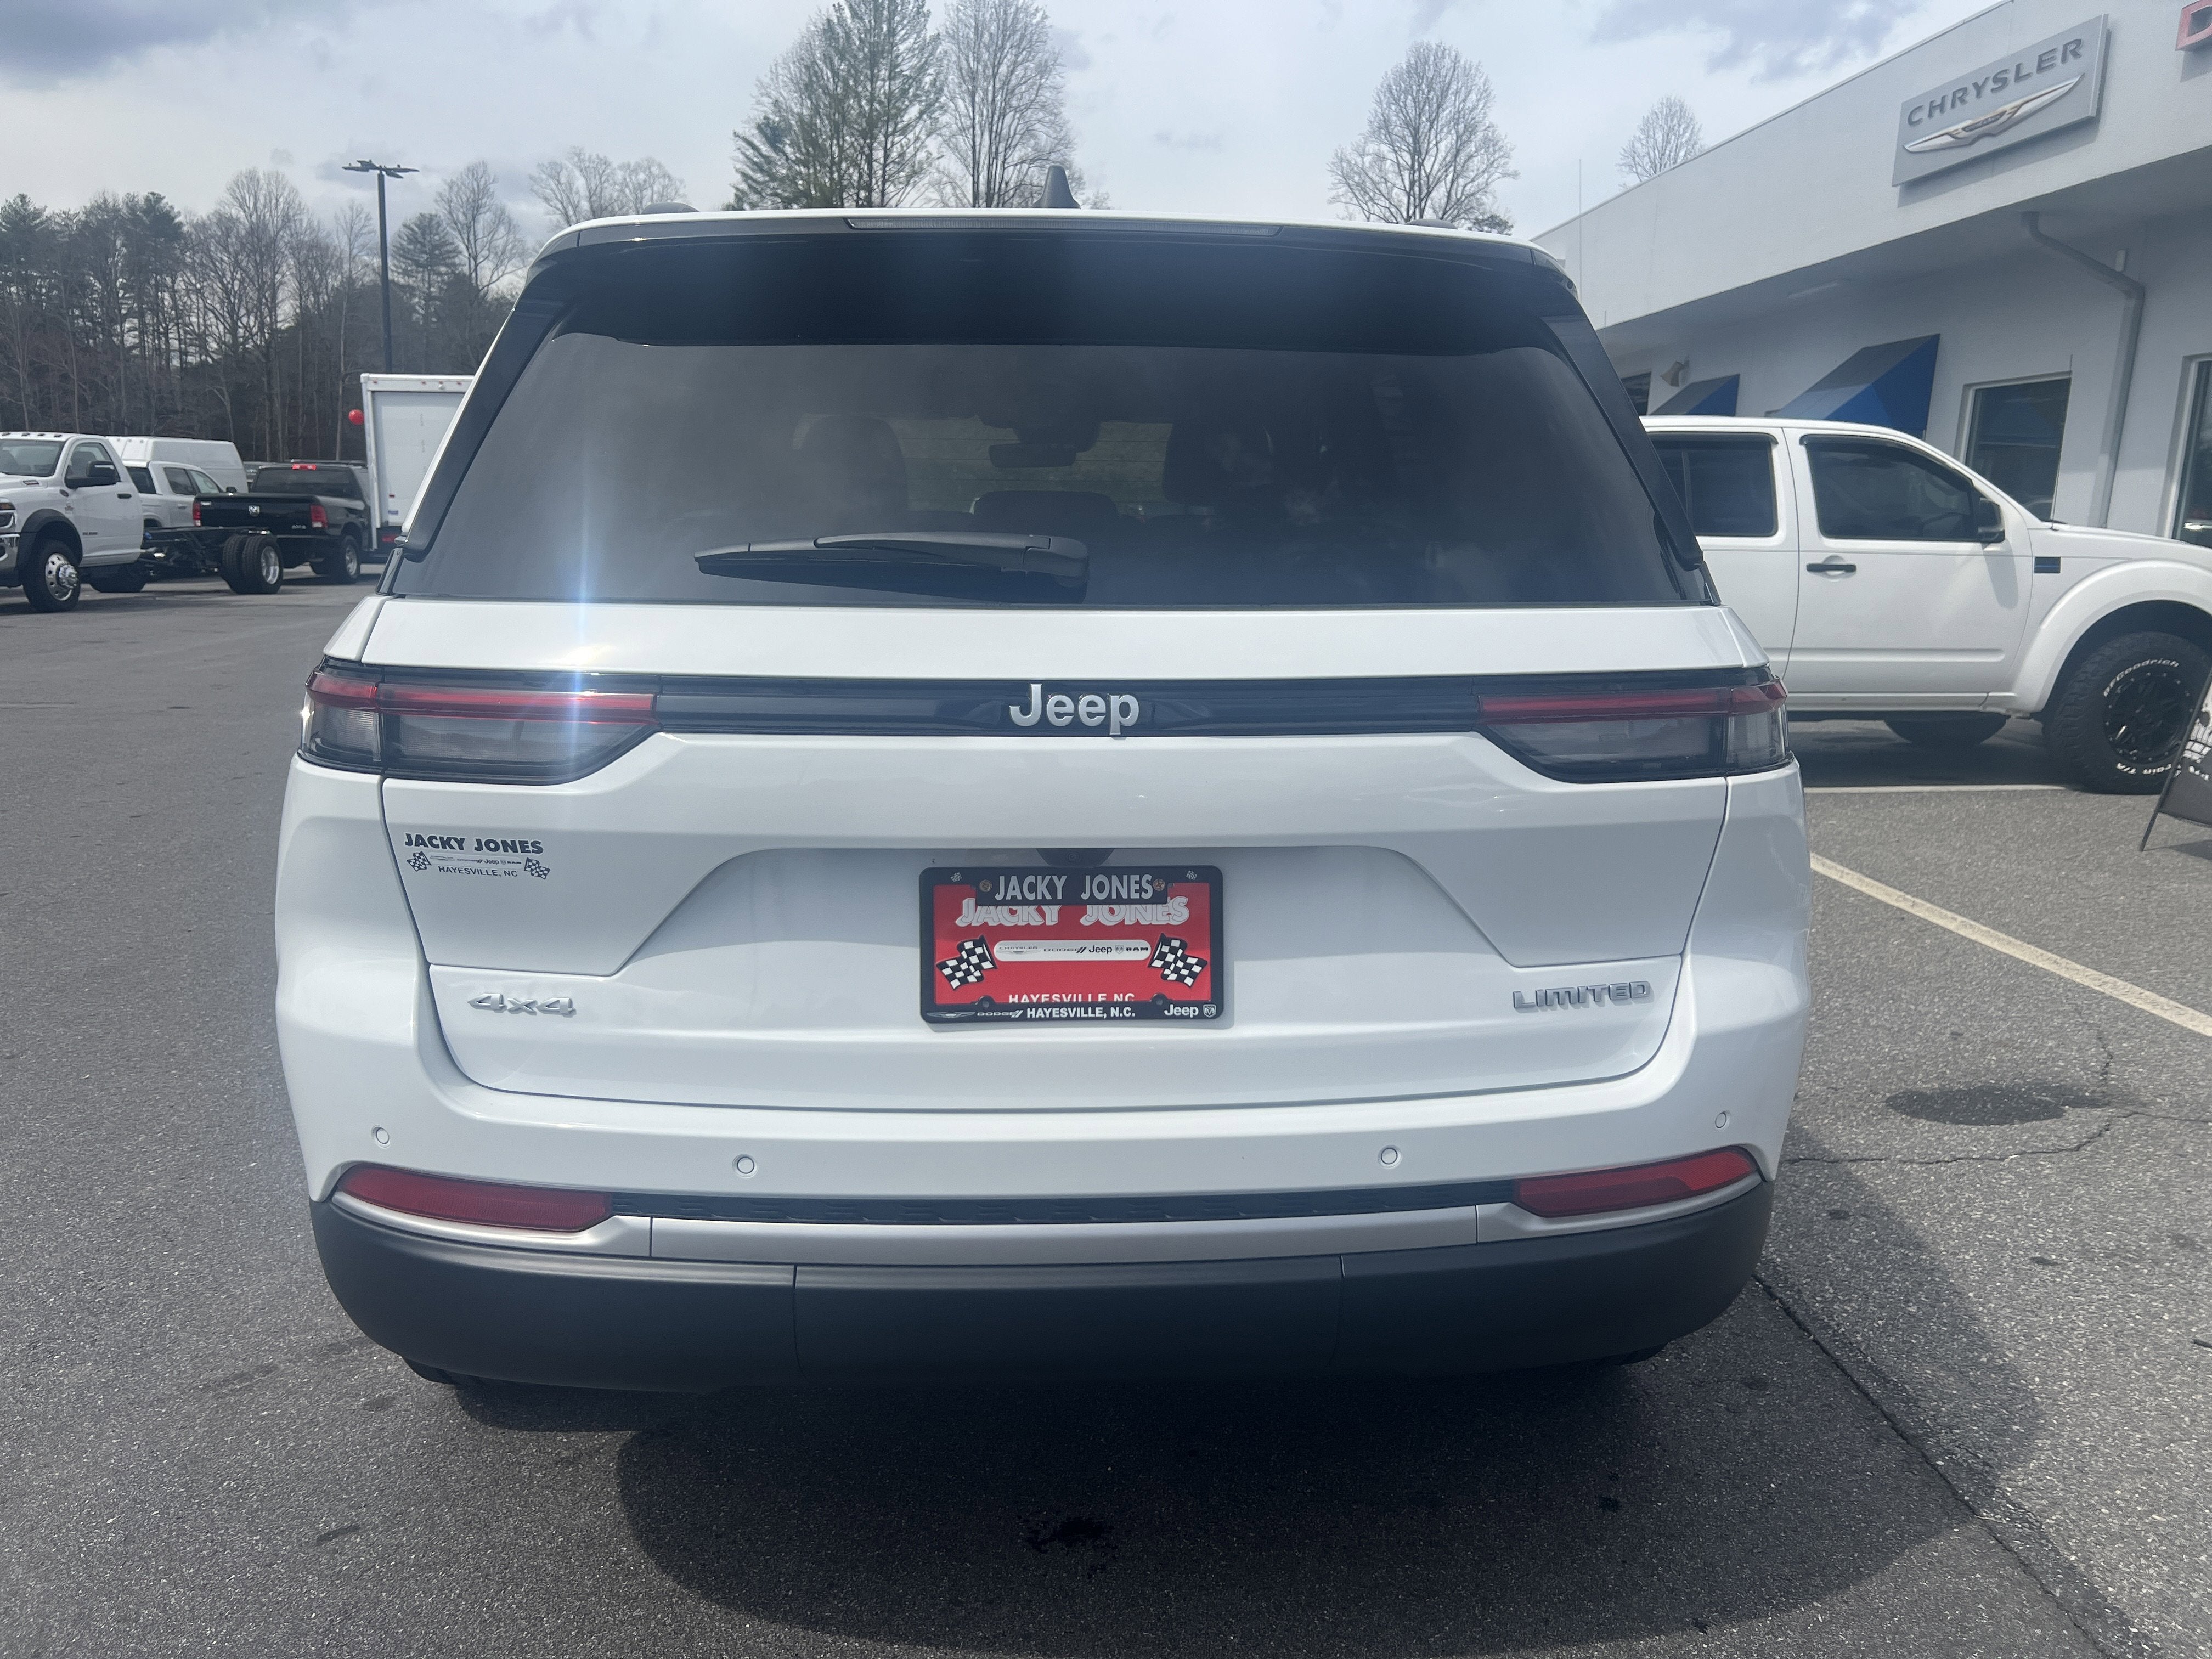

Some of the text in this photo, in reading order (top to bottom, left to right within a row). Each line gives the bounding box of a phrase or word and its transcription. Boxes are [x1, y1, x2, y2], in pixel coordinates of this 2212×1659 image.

[1907, 38, 2082, 126] CHRYSLER
[1009, 683, 1139, 735] Jeep
[405, 833, 544, 854] JACKY JONES
[438, 866, 501, 877] HAYESVILLE,
[995, 874, 1152, 900] JACKY JONES
[956, 896, 1189, 927] JACKY JONES
[1088, 945, 1113, 955] Jeep
[467, 992, 575, 1015] 4x4
[1513, 980, 1651, 1008] LIMITED
[1026, 1007, 1107, 1019] HAYESVILLE,
[1110, 1006, 1136, 1018] N.C.
[1164, 1003, 1199, 1018] Jeep
